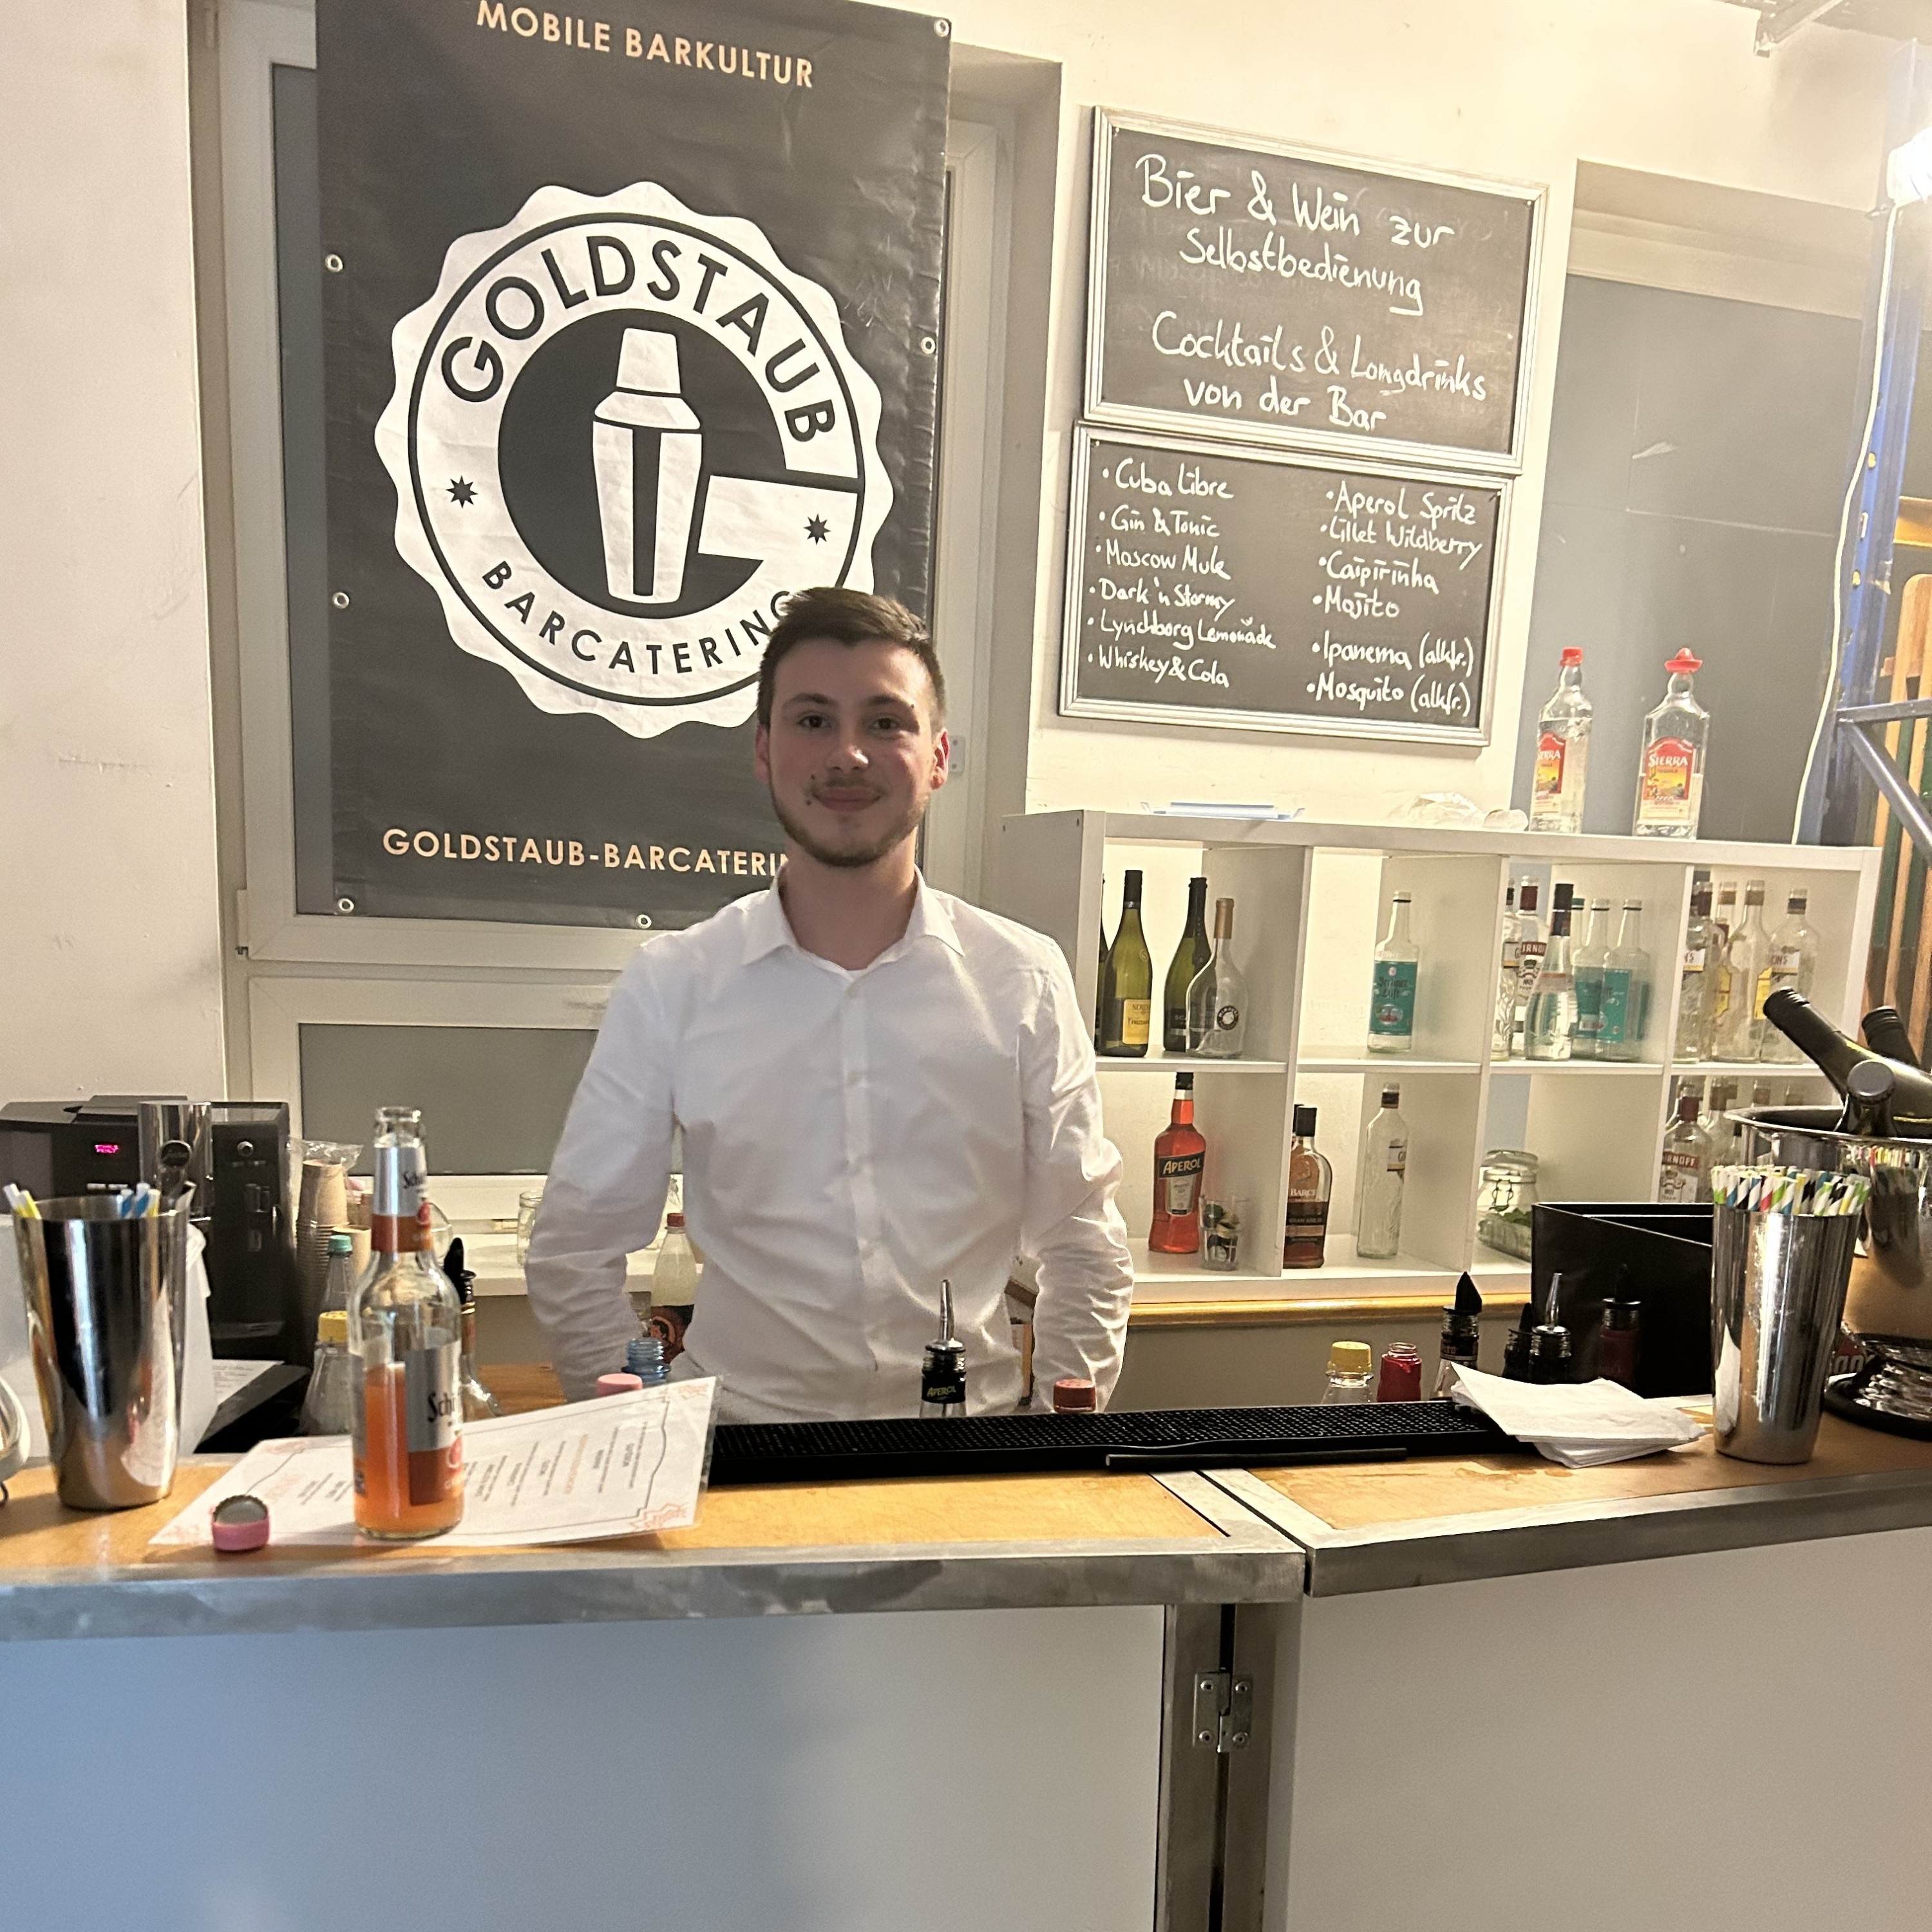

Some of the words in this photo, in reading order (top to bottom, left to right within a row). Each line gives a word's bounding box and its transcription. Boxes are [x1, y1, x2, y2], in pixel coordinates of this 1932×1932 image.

[477, 0, 611, 52] MOBILE
[626, 28, 813, 88] BARKULTUR
[1136, 155, 1231, 214] Bier
[1248, 171, 1276, 225] &
[1293, 183, 1359, 235] Wein
[1390, 215, 1455, 249] zur
[1180, 227, 1423, 316] Selbstbedienung
[441, 235, 836, 442] GOLDSTAUB
[1152, 311, 1305, 372] Cocktails
[1315, 327, 1340, 374] &
[1350, 335, 1486, 401] Longdrinks
[1184, 379, 1242, 409] von
[1260, 376, 1310, 415] der
[1328, 386, 1387, 430] Bar
[1115, 458, 1172, 497] Cuba
[1178, 462, 1233, 498] Libre
[1111, 504, 1144, 531] Gin
[1153, 507, 1171, 536] &
[1170, 511, 1220, 536] Tonic
[1334, 480, 1408, 519] Aperol
[1419, 492, 1476, 530] Spritz
[1106, 538, 1177, 569] Moscow
[1182, 544, 1231, 580] Mule
[1330, 516, 1377, 544] Lillet
[1387, 521, 1482, 571] Wildberry
[1327, 550, 1439, 594] Caipirinha
[1099, 578, 1150, 604] Dark
[1174, 583, 1235, 621] Stormy
[1325, 585, 1399, 619] Mojito
[1324, 630, 1412, 670] Ipanema
[1188, 659, 1229, 688] Cola
[1316, 671, 1404, 710] Mosquito
[1649, 754, 1689, 767] SIERRA
[1163, 1157, 1200, 1175] APEROL
